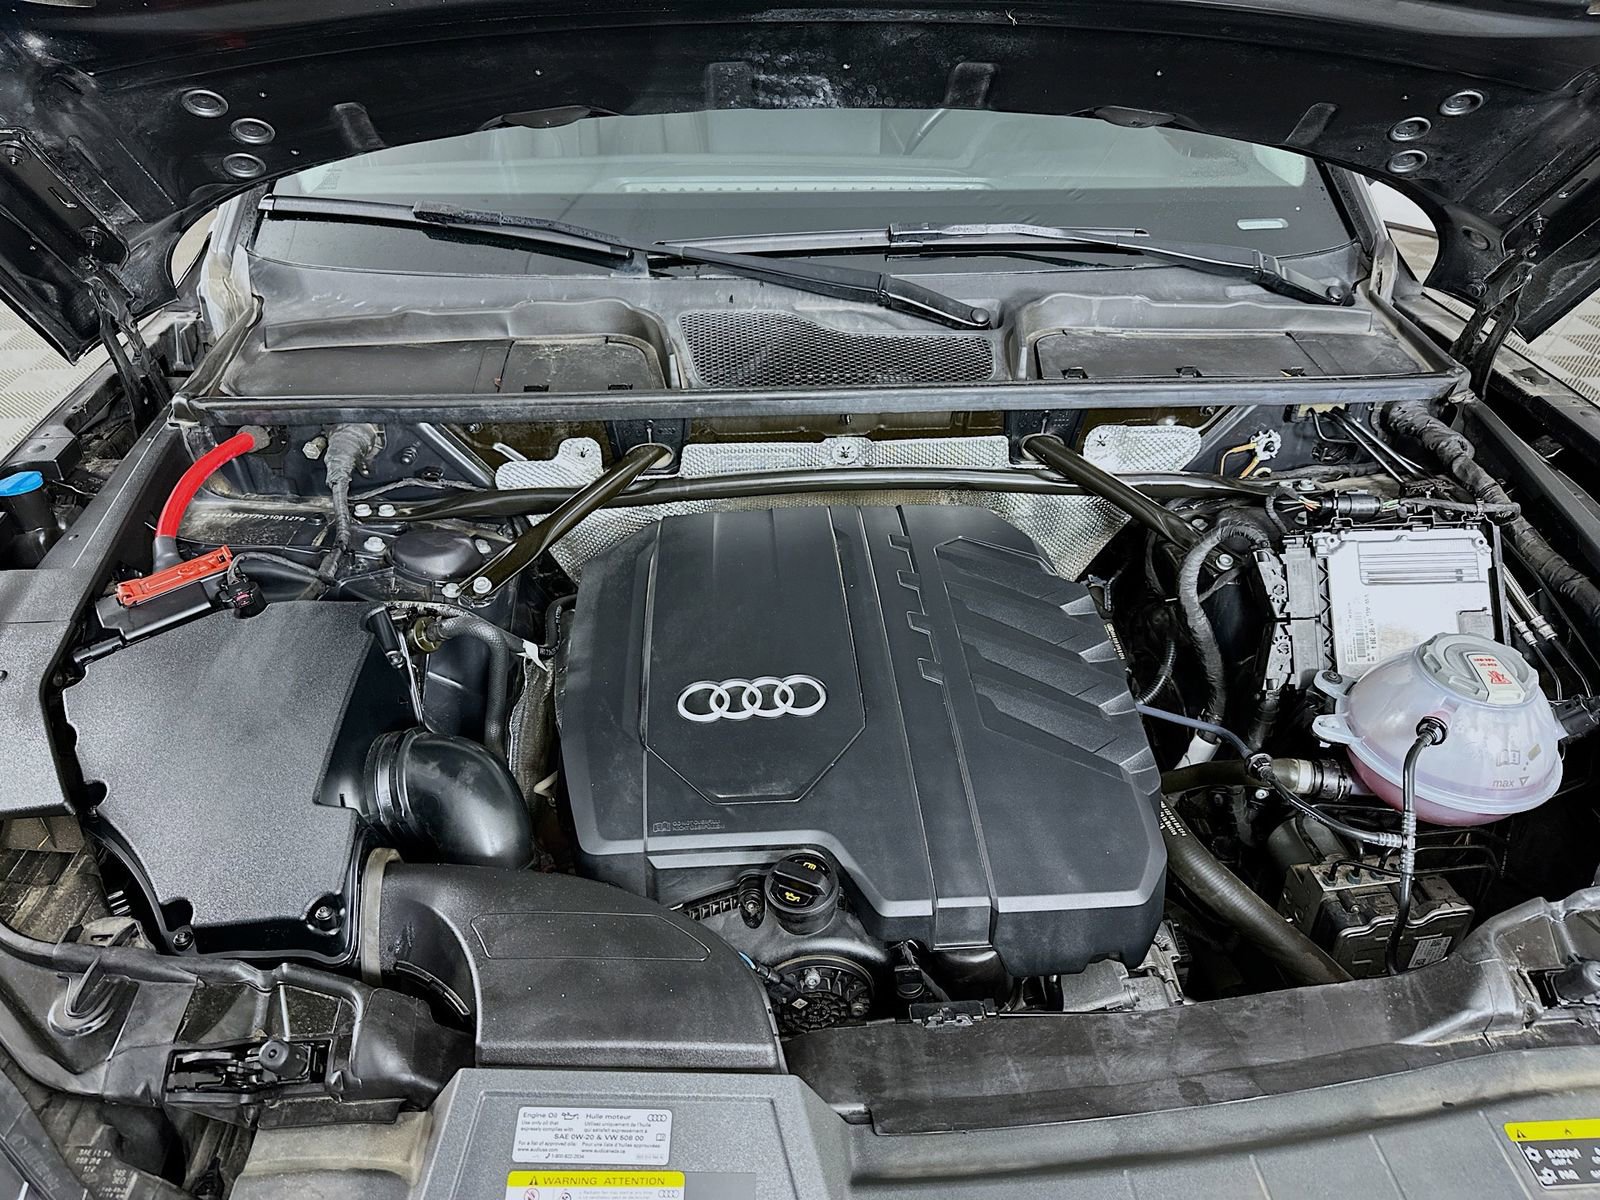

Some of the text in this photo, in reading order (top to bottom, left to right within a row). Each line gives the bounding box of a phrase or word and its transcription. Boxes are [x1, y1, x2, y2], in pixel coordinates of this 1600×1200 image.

[1492, 779, 1515, 788] max
[523, 1111, 558, 1120] Engine Oil
[543, 1177, 665, 1186] WARNING ATTENTION
